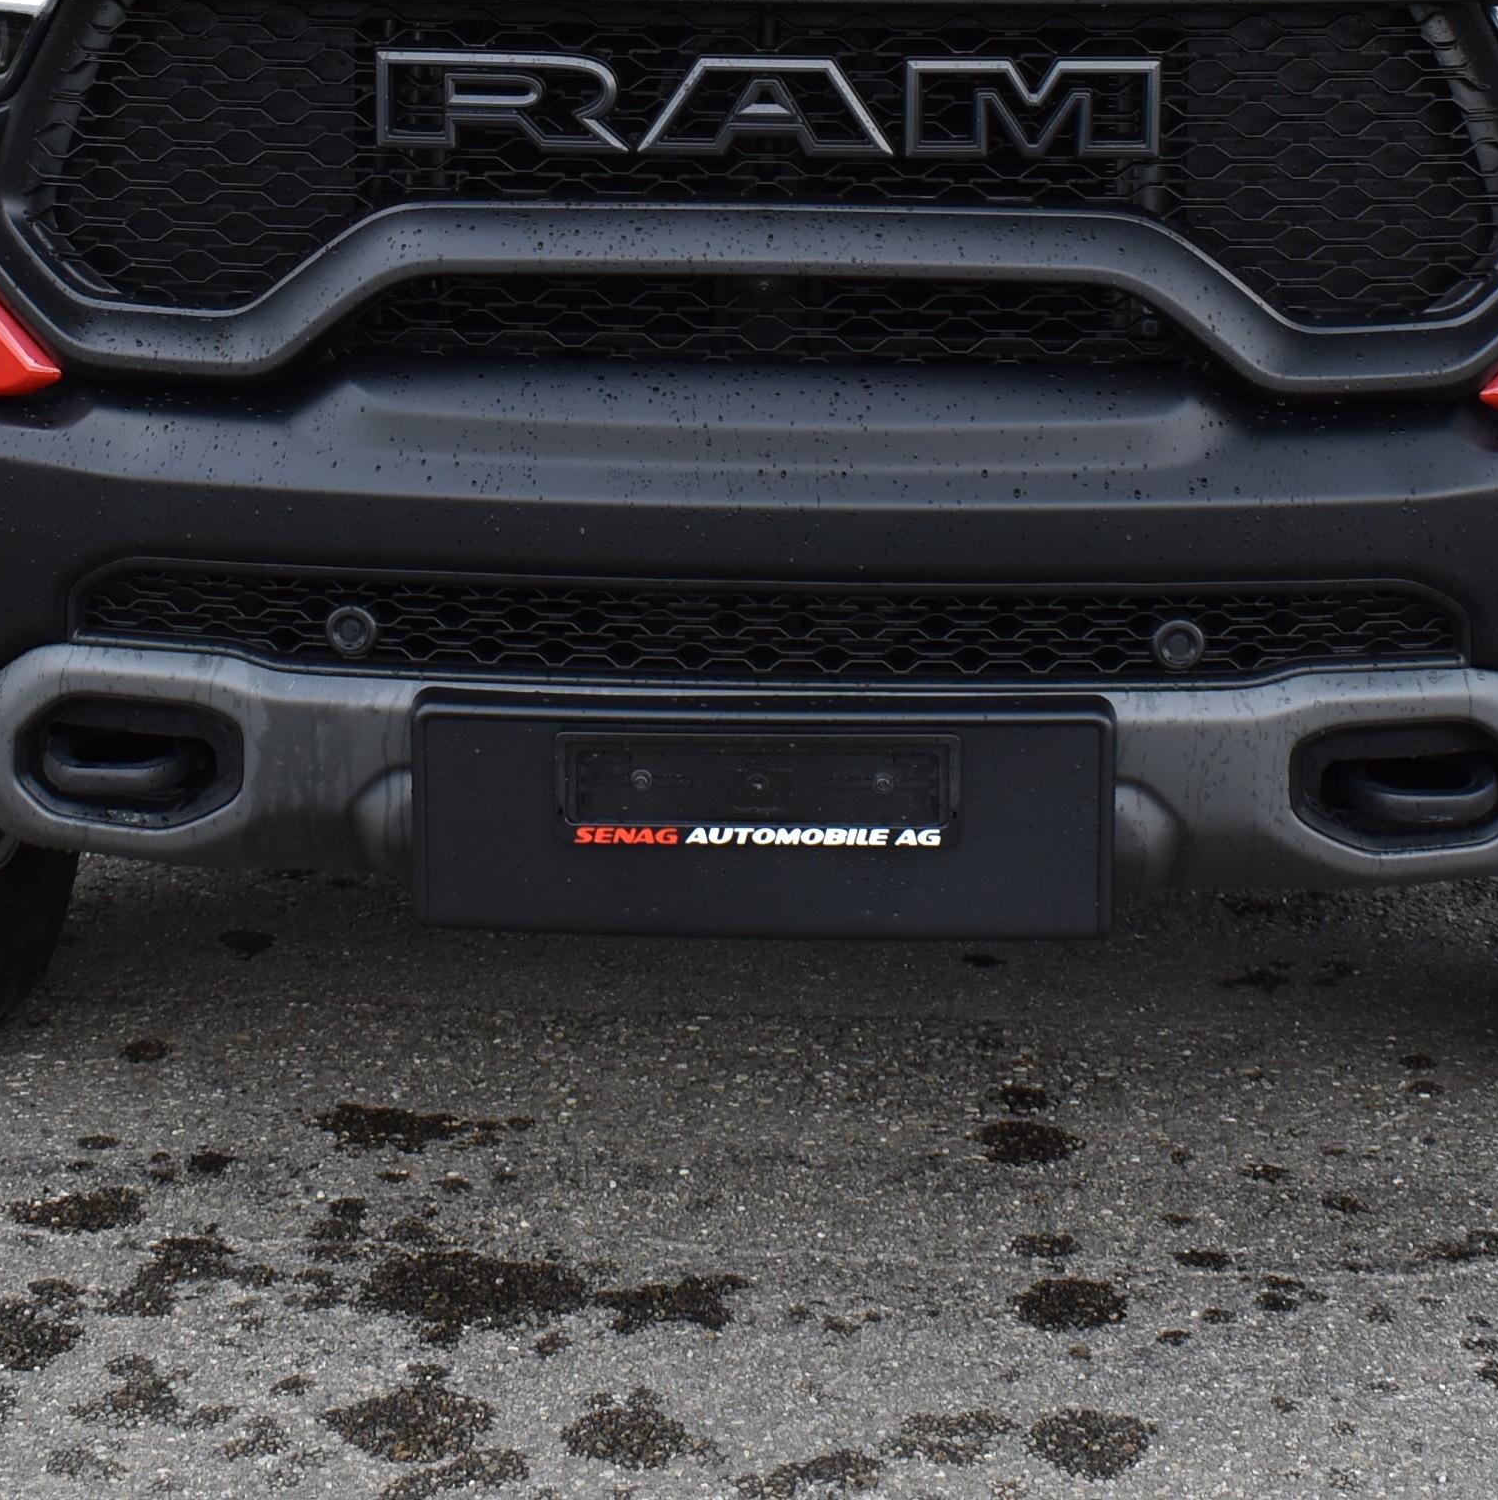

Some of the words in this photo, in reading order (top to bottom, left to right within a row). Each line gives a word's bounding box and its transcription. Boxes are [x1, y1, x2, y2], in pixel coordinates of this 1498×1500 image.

[374, 48, 1164, 158] RAM
[573, 826, 679, 846] SENAG
[685, 826, 889, 847] AUTOMOBILE
[894, 826, 942, 847] AG
